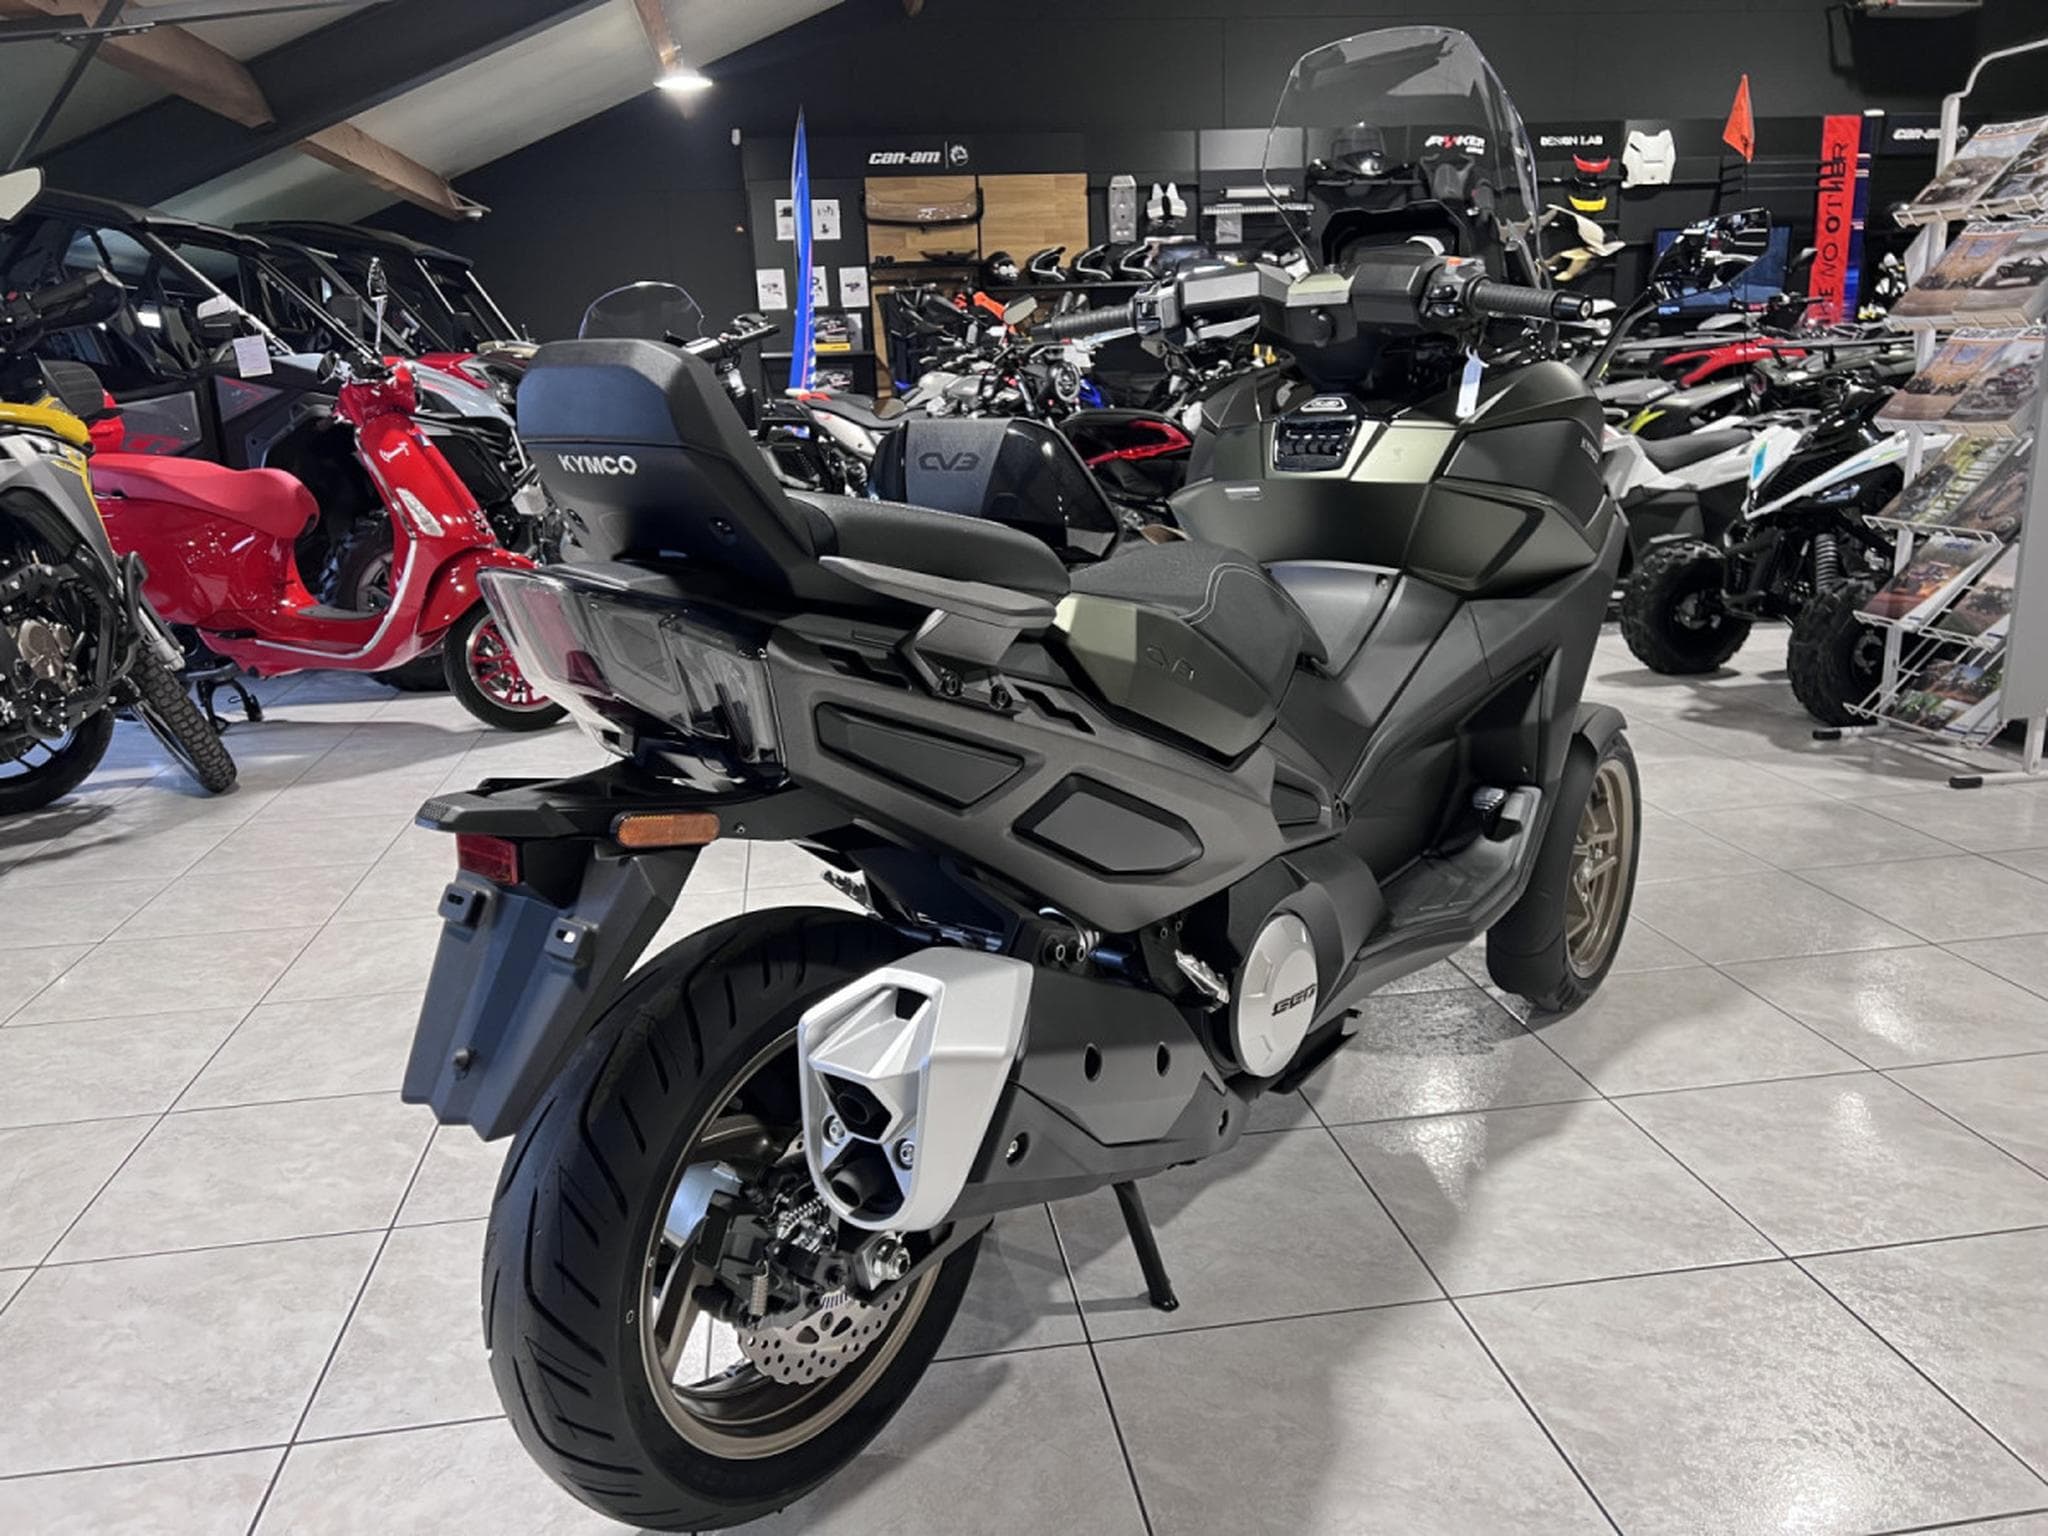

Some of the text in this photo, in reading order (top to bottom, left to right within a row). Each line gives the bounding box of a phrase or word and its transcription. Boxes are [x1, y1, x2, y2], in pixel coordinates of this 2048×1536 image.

[867, 151, 941, 165] can-am
[557, 453, 638, 475] KYMCO
[918, 452, 981, 471] CV3
